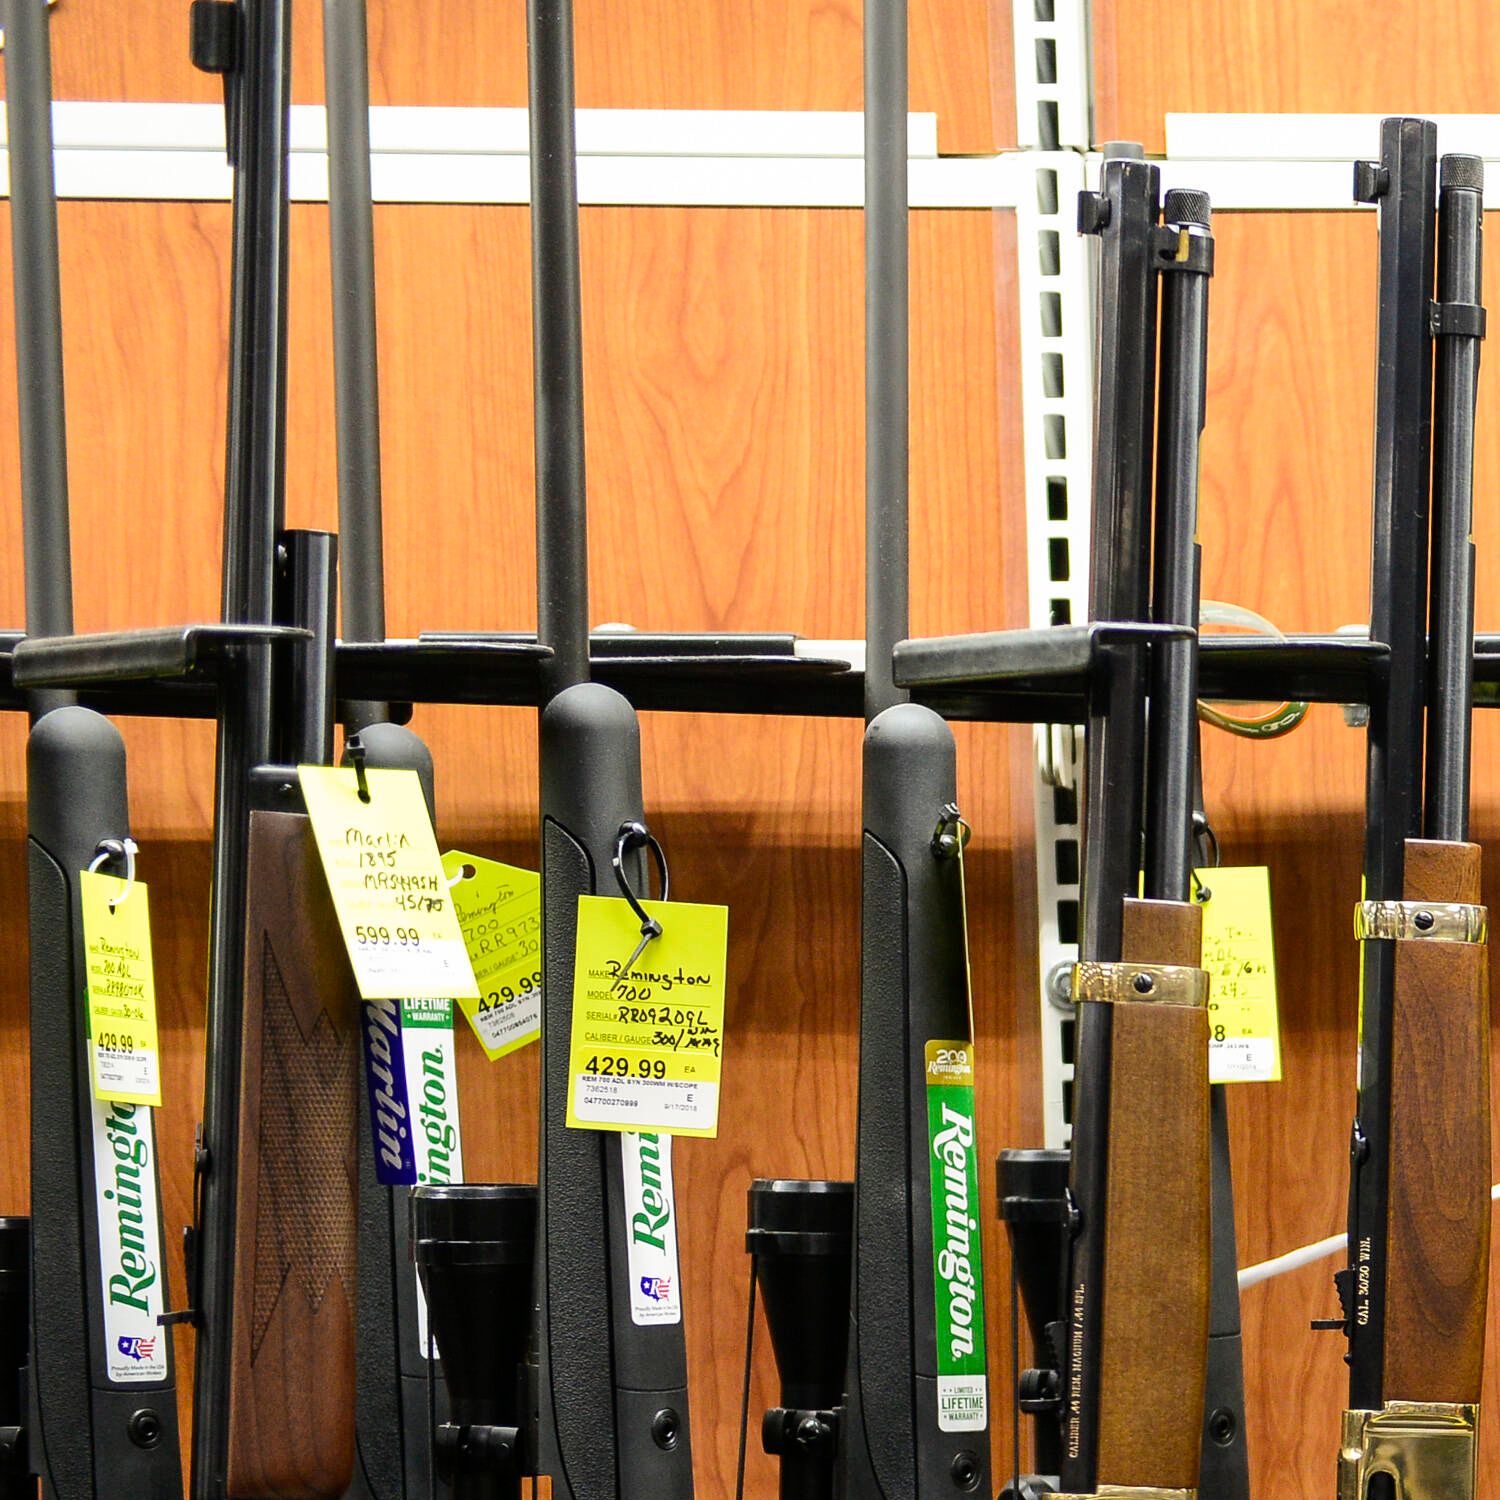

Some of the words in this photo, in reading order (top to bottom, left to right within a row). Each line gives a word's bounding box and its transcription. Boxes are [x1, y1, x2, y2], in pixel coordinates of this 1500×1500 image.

[356, 926, 420, 947] 599.99
[589, 969, 609, 978] MAKE
[478, 971, 542, 1014] 429.99
[587, 990, 614, 1000] MODEL
[617, 985, 651, 1000] 700
[586, 1011, 618, 1020] SERIAL#
[98, 1032, 133, 1054] 429.99
[585, 1032, 618, 1042] CALIBER
[624, 1034, 651, 1045] GAUGE
[585, 1056, 666, 1079] 429.99
[684, 1065, 696, 1073] EA
[933, 1102, 977, 1358] Remington
[942, 1397, 983, 1409] LIFETIME
[949, 1412, 978, 1421] WARRANTY
